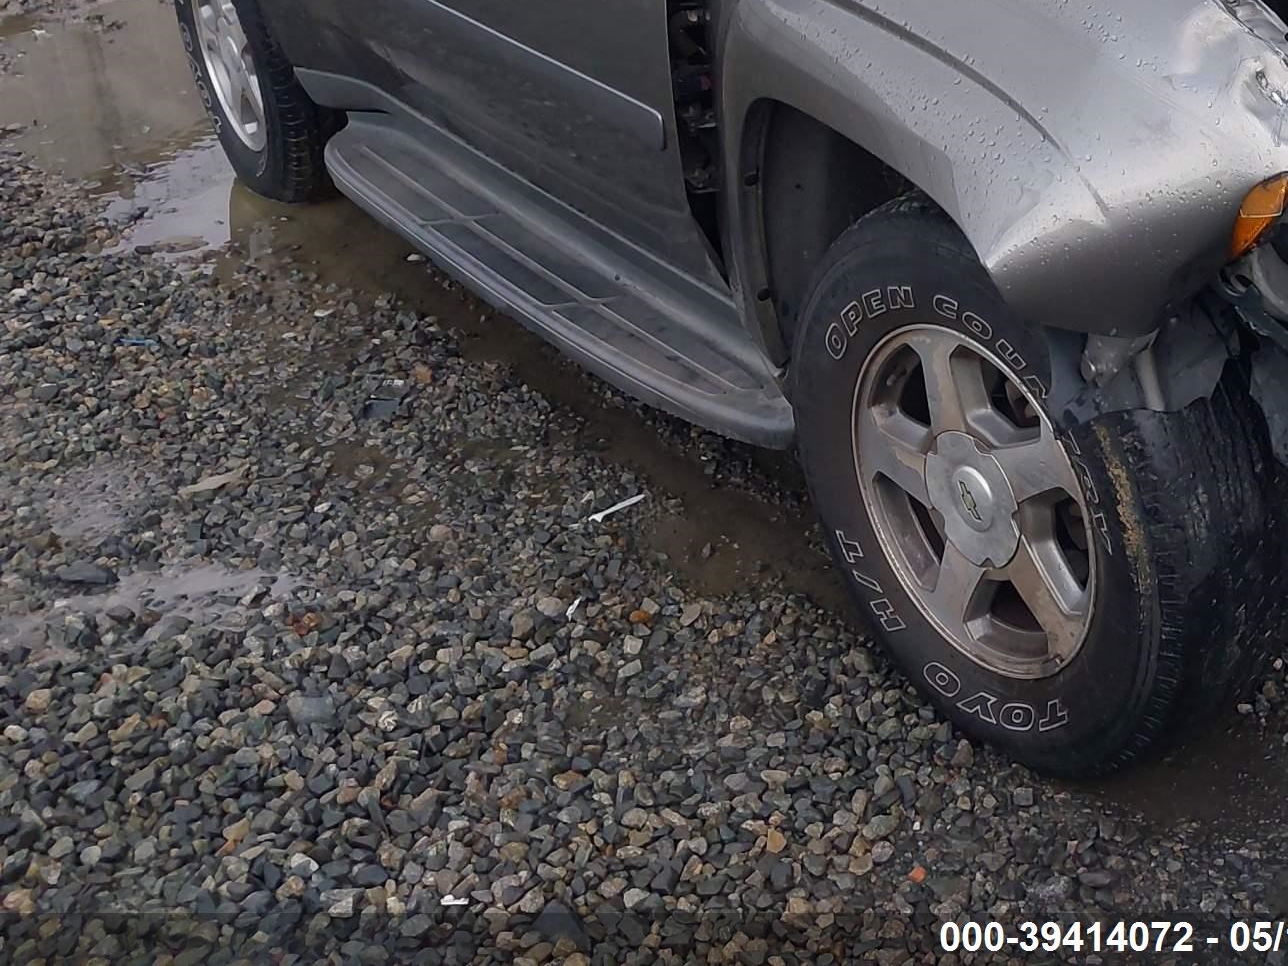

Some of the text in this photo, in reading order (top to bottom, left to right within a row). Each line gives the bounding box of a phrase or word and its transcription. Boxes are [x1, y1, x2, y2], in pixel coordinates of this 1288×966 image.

[824, 285, 915, 361] OPEN
[835, 529, 908, 632] H/T
[922, 661, 1069, 733] TOYO
